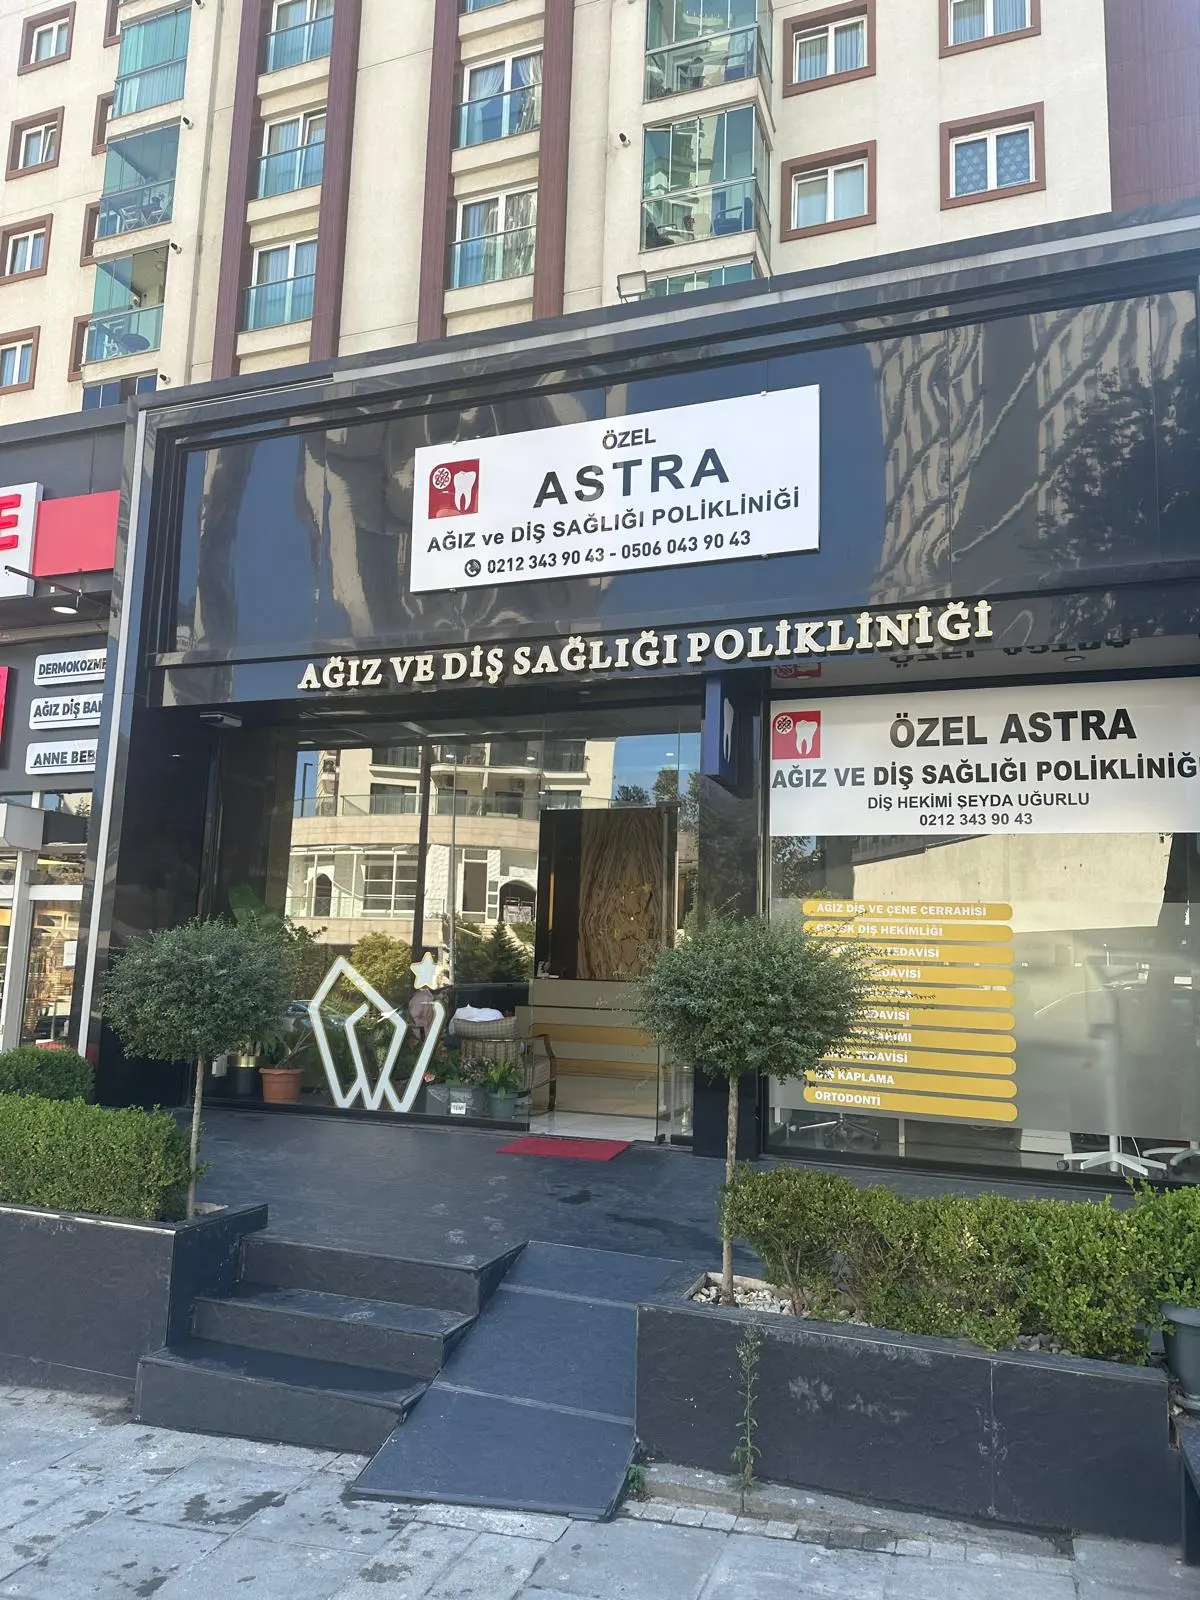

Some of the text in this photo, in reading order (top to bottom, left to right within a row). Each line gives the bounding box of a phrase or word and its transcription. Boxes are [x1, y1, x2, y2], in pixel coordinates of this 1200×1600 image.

[603, 428, 656, 450] ÖZEL
[533, 448, 730, 508] ASTRA
[427, 486, 799, 553] AĞIZ ve DİŞ SAĞLIĞI POLİKLİNİĞİ
[487, 557, 524, 574] 0212
[528, 554, 557, 570] 343
[562, 551, 581, 565] 90
[584, 548, 605, 563] 43
[621, 542, 662, 560] 0506
[667, 537, 698, 554] 043
[703, 534, 724, 549] 90
[729, 529, 751, 547] 43
[297, 656, 382, 690] AĞIZ
[390, 654, 434, 684] VE
[442, 645, 503, 685] DİŞ
[512, 630, 678, 676] SAĞLIĞI
[687, 600, 993, 663] POLİKLİNİĞİ
[34, 701, 60, 718] AĞIZ
[62, 698, 80, 718] DİŞ
[889, 708, 1137, 749] ÖZEL ASTRA
[33, 751, 68, 766] ANNE
[771, 751, 1200, 790] AĞIZ VE DİŞ SAĞLIĞI POLİKLİNİĞ
[868, 790, 1090, 812] DİŞ HEKİMİ ŞEYDA UĞURLU
[919, 812, 1033, 827] 0212 343 90 43
[817, 901, 843, 913] AĞIZ
[868, 904, 884, 914] VE
[858, 923, 878, 936] DİŞ
[880, 924, 943, 937] HEKİMLİĞİ
[886, 945, 940, 958] TEDAVİSİ
[838, 1070, 895, 1085] KAPLAMA
[815, 1090, 881, 1106] ORTODONTİ
